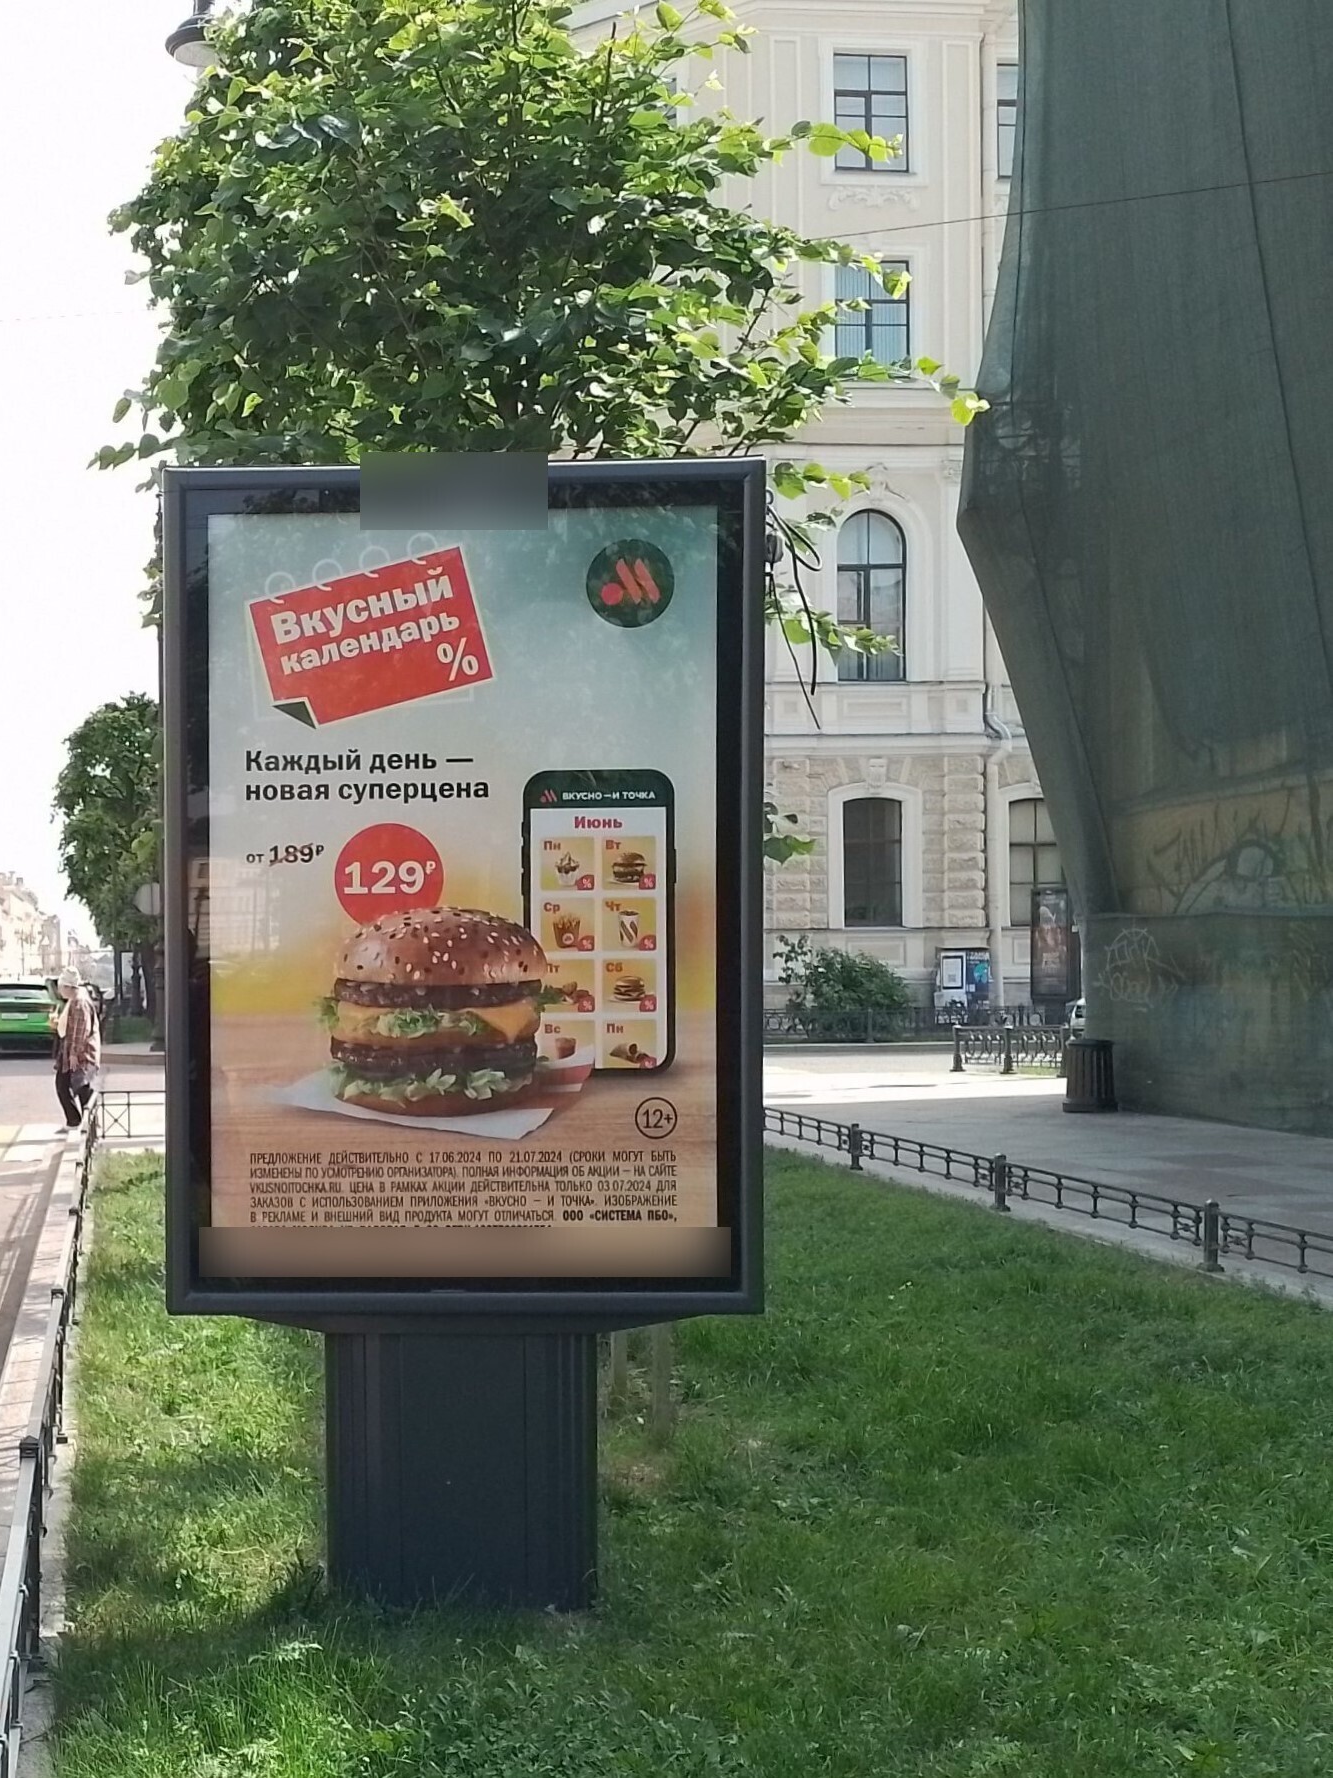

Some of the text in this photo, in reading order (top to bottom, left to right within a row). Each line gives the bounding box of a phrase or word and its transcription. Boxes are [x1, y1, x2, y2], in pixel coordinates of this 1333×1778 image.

[270, 566, 454, 645] Вкусный
[280, 609, 460, 676] календарь
[436, 637, 479, 682] %
[244, 748, 362, 774] Каждый
[369, 751, 437, 774] день
[244, 780, 490, 806] новая суперцена
[562, 792, 602, 800] ВКУСНО
[622, 791, 655, 800] ТОЧКА
[573, 815, 623, 830] Июнь
[544, 840, 561, 851] Пн
[605, 840, 622, 851] Вт
[246, 853, 265, 863] от
[544, 903, 561, 914] Ср
[605, 901, 622, 912] Чт
[606, 962, 623, 973] Сб
[545, 1024, 562, 1035] Вс
[607, 1023, 625, 1034] Пн
[642, 1110, 674, 1129] 12+
[250, 1153, 322, 1165] ПРЕДЛОЖЕНИЕ
[328, 1151, 409, 1164] ДЕЙСТВИТЕЛЬНО
[416, 1152, 423, 1163] С
[488, 1152, 502, 1163] ПО
[509, 1152, 562, 1163] 21.07.2024
[569, 1151, 605, 1163] (СРОКИ
[612, 1151, 644, 1162] МОГУТ
[651, 1151, 677, 1162] БЫТЬ
[250, 1168, 302, 1178] ИЗМЕНЕНЫ
[305, 1168, 318, 1178] ПО
[321, 1168, 384, 1178] УСМОТРЕНИЮ
[462, 1167, 499, 1177] ПОЛНАЯ
[502, 1167, 568, 1178] ИНФОРМАЦИЯ
[571, 1166, 585, 1176] ОБ
[587, 1166, 620, 1177] АКЦИИ
[633, 1166, 646, 1176] НА
[648, 1165, 677, 1176] САЙТЕ
[349, 1182, 374, 1193] ЦЕНА
[379, 1182, 386, 1192] В
[390, 1182, 427, 1192] РАМКАХ
[432, 1182, 465, 1193] АКЦИИ
[470, 1180, 550, 1193] ДЕЙСТВИТЕЛЬНА
[555, 1181, 593, 1191] ТОЛЬКО
[655, 1181, 677, 1192] ДЛЯ
[250, 1197, 293, 1207] ЗАКАЗОВ
[299, 1197, 306, 1207] С
[311, 1196, 404, 1207] ИСПОЛЬЗОВАНИЕМ
[410, 1196, 478, 1207] ПРИЛОЖЕНИЯ
[547, 1196, 555, 1206] И
[604, 1195, 678, 1206] ИЗОБРАЖЕНИЕ
[250, 1211, 257, 1222] В
[262, 1211, 306, 1222] РЕКЛАМЕ
[311, 1211, 318, 1222] И
[324, 1210, 374, 1222] ВНЕШНИЙ
[379, 1211, 399, 1222] ВИД
[404, 1211, 453, 1222] ПРОДУКТА
[458, 1210, 489, 1221] МОГУТ
[563, 1210, 584, 1220] ООО
[589, 1210, 642, 1220] «СИСТЕМА
